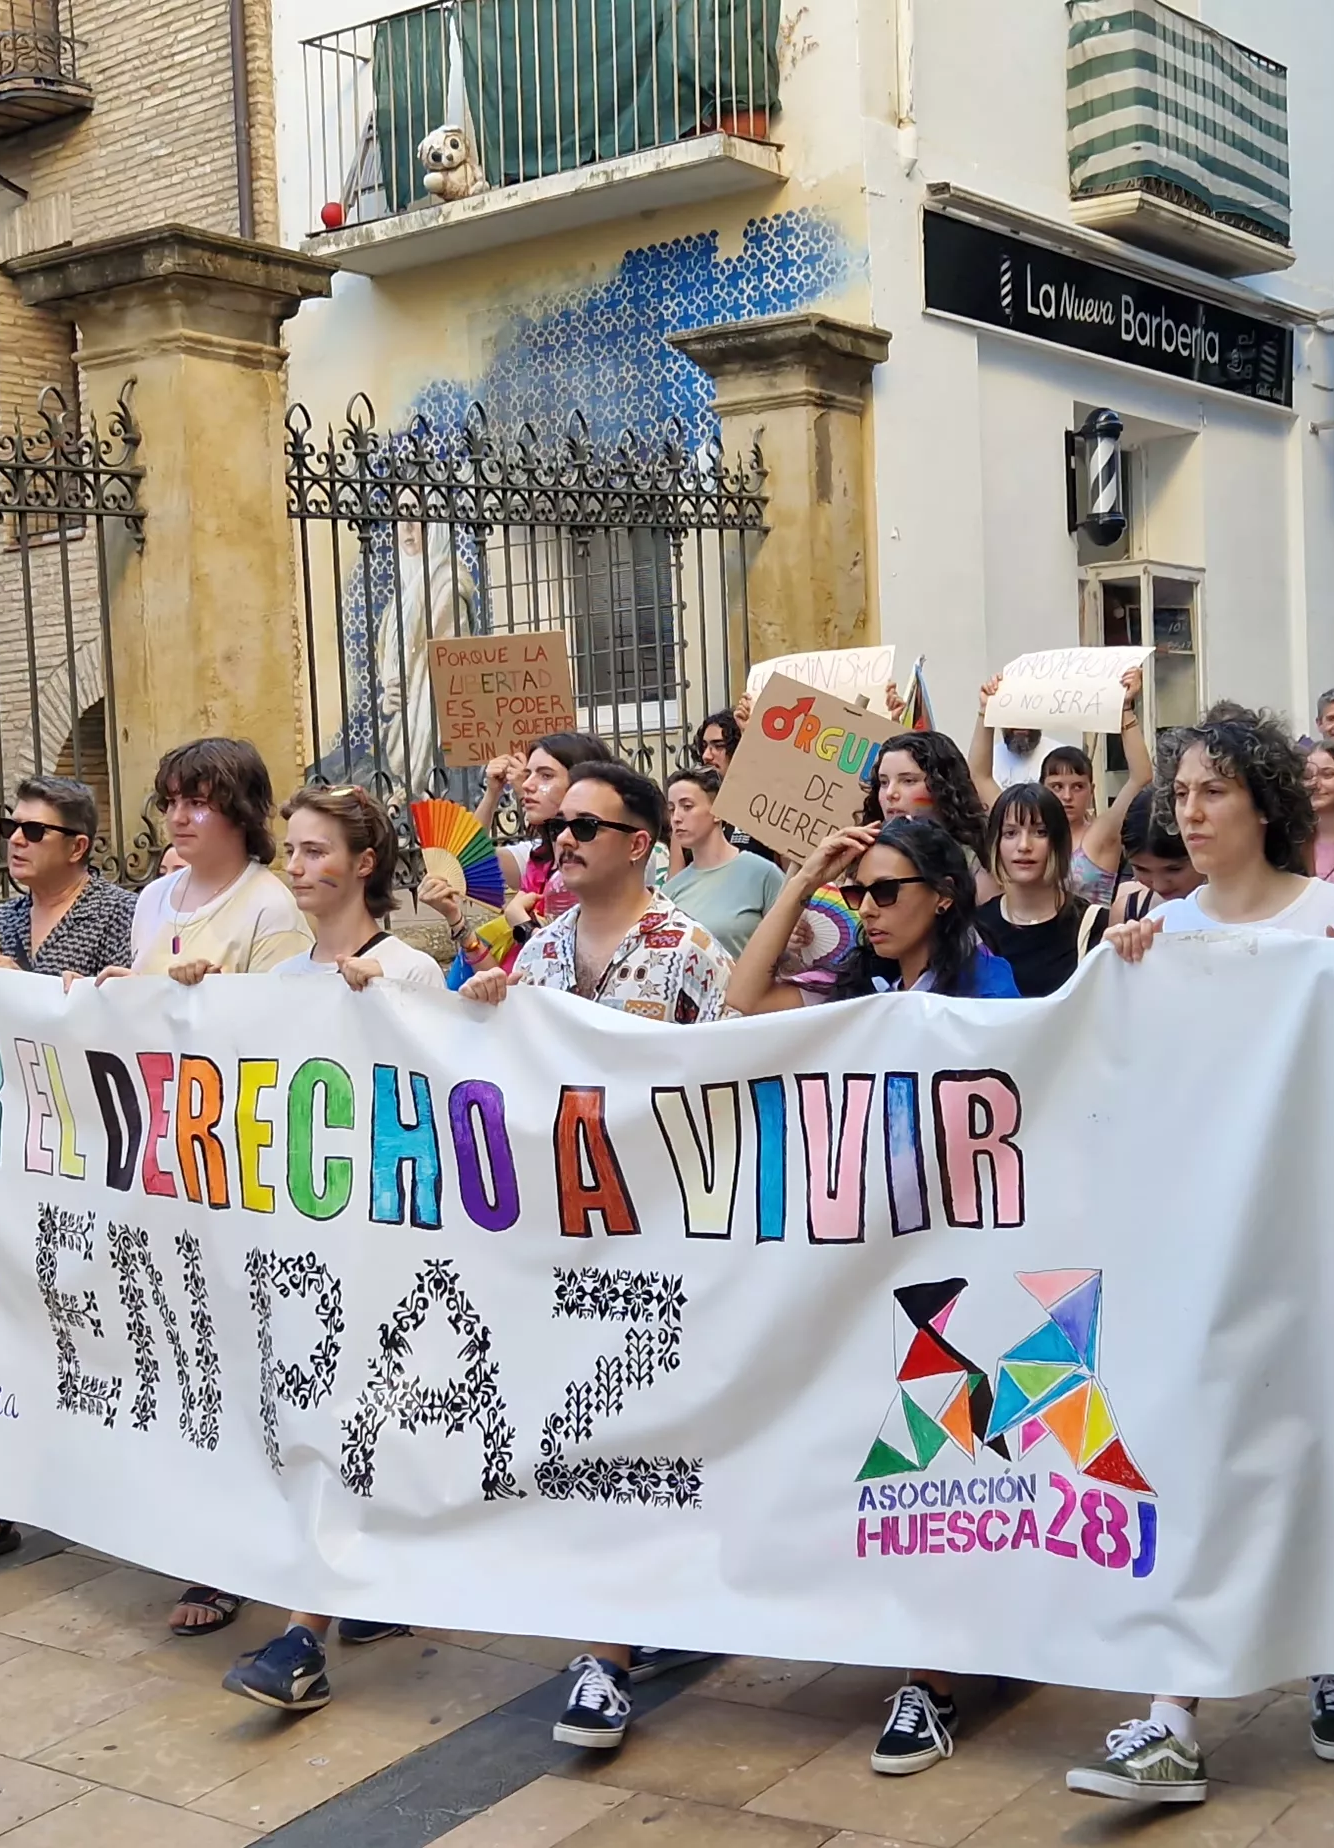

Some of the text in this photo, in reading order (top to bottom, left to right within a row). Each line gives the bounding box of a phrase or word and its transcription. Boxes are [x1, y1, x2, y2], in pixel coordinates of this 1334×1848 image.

[1026, 263, 1055, 319] La
[1059, 281, 1116, 325] Nueva
[436, 645, 548, 667] PORQUE LA
[446, 695, 566, 718] ES PODER
[999, 687, 1108, 716] O NO SERÁ
[450, 721, 491, 740] SER
[495, 719, 504, 738] Y
[761, 696, 883, 788] ORGUL
[468, 741, 497, 762] SIN
[803, 774, 843, 812] DE
[14, 1037, 86, 1180] EL
[85, 1050, 520, 1233] DERECHO
[553, 1085, 641, 1238] A
[651, 1067, 1026, 1245] VIVIR
[35, 1201, 705, 1509] EN PAZ
[858, 1468, 1037, 1512] ASOCIACIÓN
[857, 1471, 1158, 1578] HUESCA 28J
